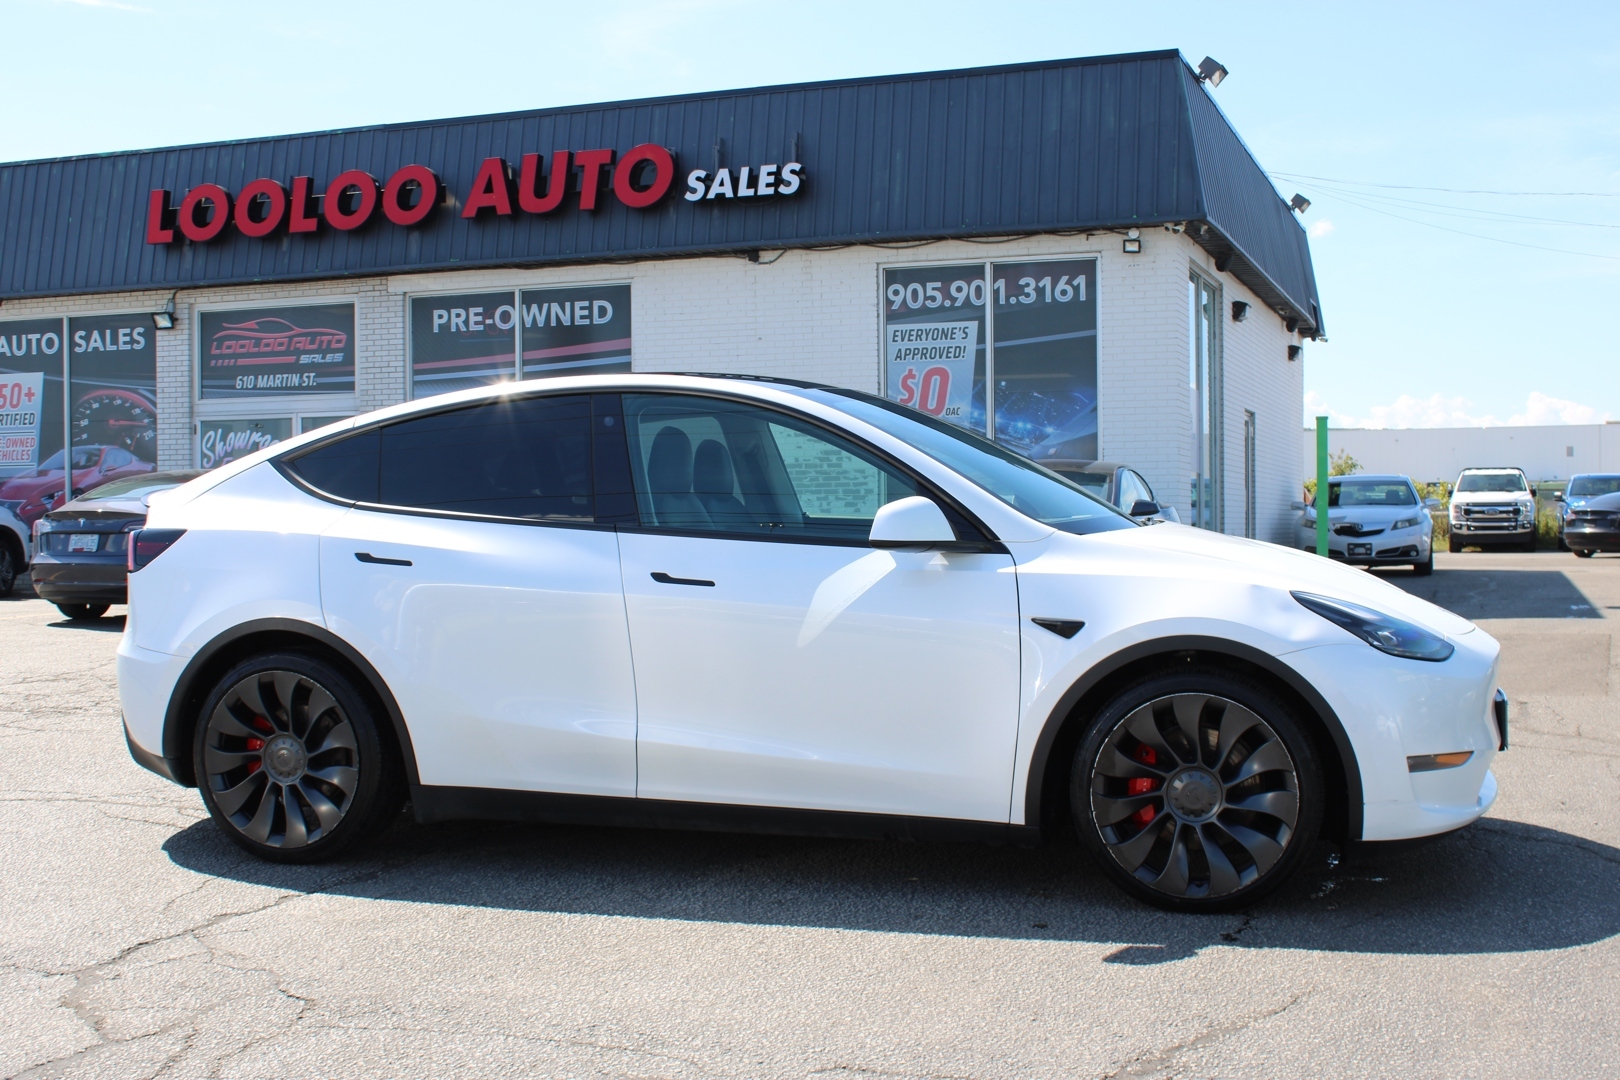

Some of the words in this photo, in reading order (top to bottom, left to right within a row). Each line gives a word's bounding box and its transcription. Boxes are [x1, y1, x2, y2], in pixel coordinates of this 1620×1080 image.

[147, 164, 438, 244] LOOLOO
[461, 143, 674, 219] AUTO
[684, 162, 802, 202] SALES
[887, 274, 1087, 310] 905.901.3161
[432, 300, 613, 333] PRE-OWNED
[0, 332, 60, 357] AUTO
[74, 327, 145, 353] SALES
[210, 338, 290, 355] LOOLOO
[290, 334, 347, 351] AUTO
[892, 326, 969, 343] EVERYONE'S
[299, 353, 344, 364] SALES
[894, 345, 967, 361] APPROVED!
[235, 375, 255, 389] 610
[257, 373, 300, 388] MARTIN
[302, 372, 317, 387] ST.
[899, 366, 950, 417] $0
[945, 407, 961, 417] OAC
